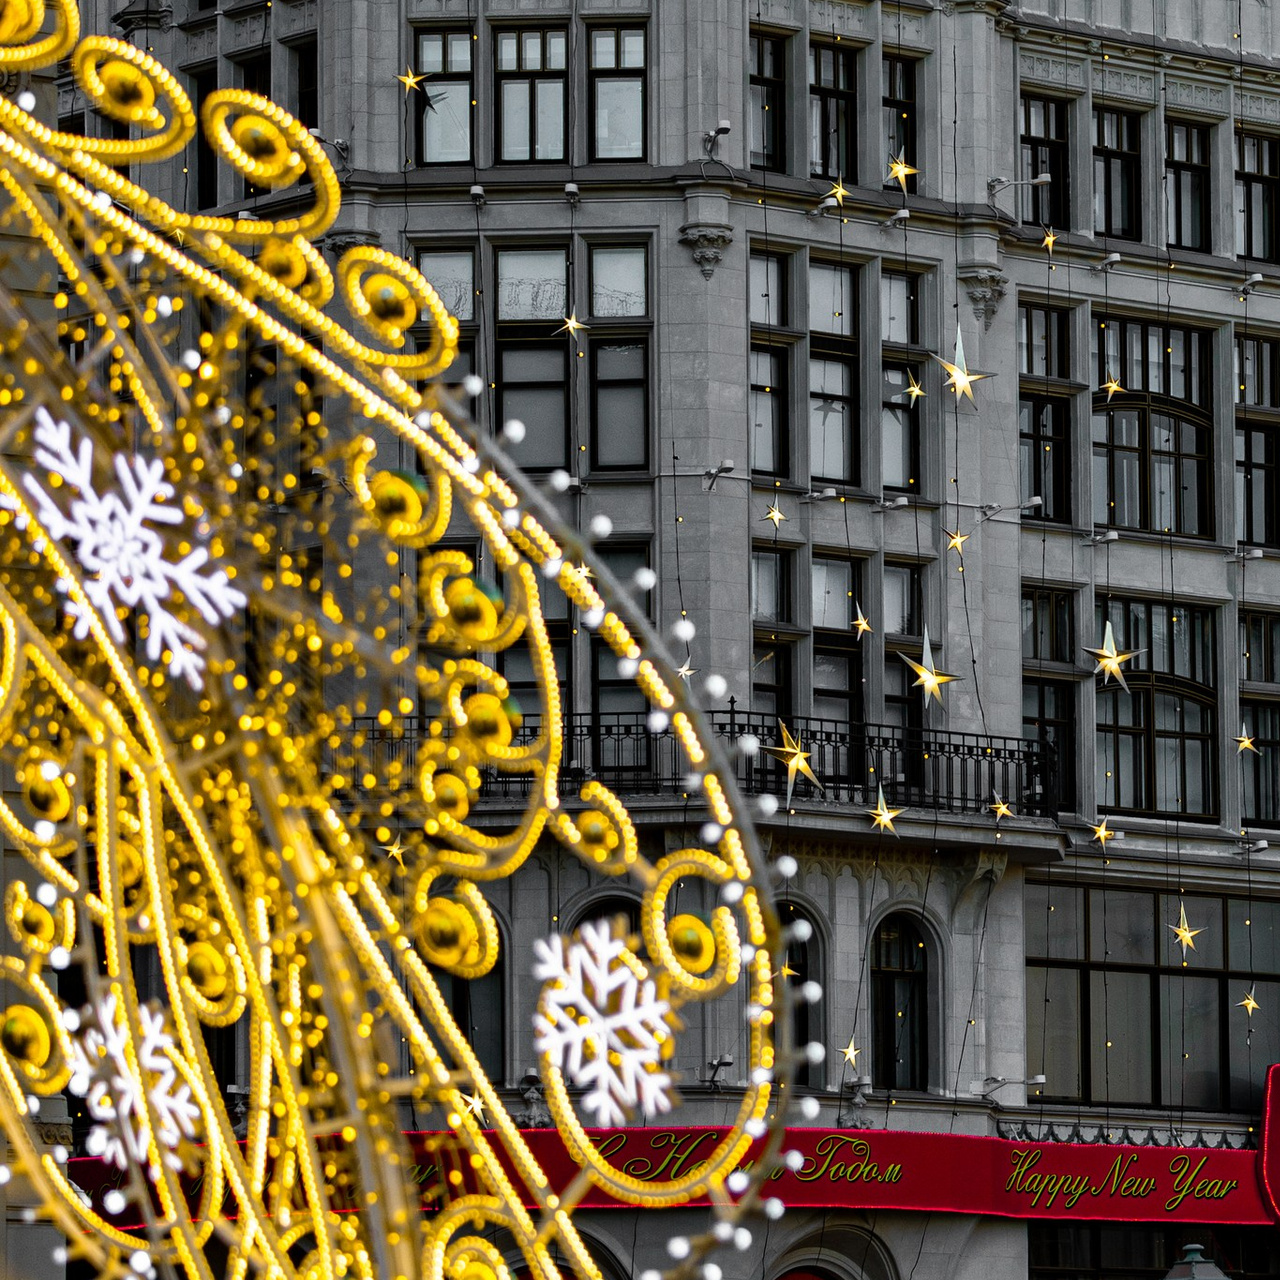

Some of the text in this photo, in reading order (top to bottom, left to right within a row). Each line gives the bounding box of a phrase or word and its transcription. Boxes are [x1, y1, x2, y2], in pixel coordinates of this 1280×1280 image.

[794, 1134, 903, 1185] Годом
[1005, 1148, 1239, 1211] Happy New Year
